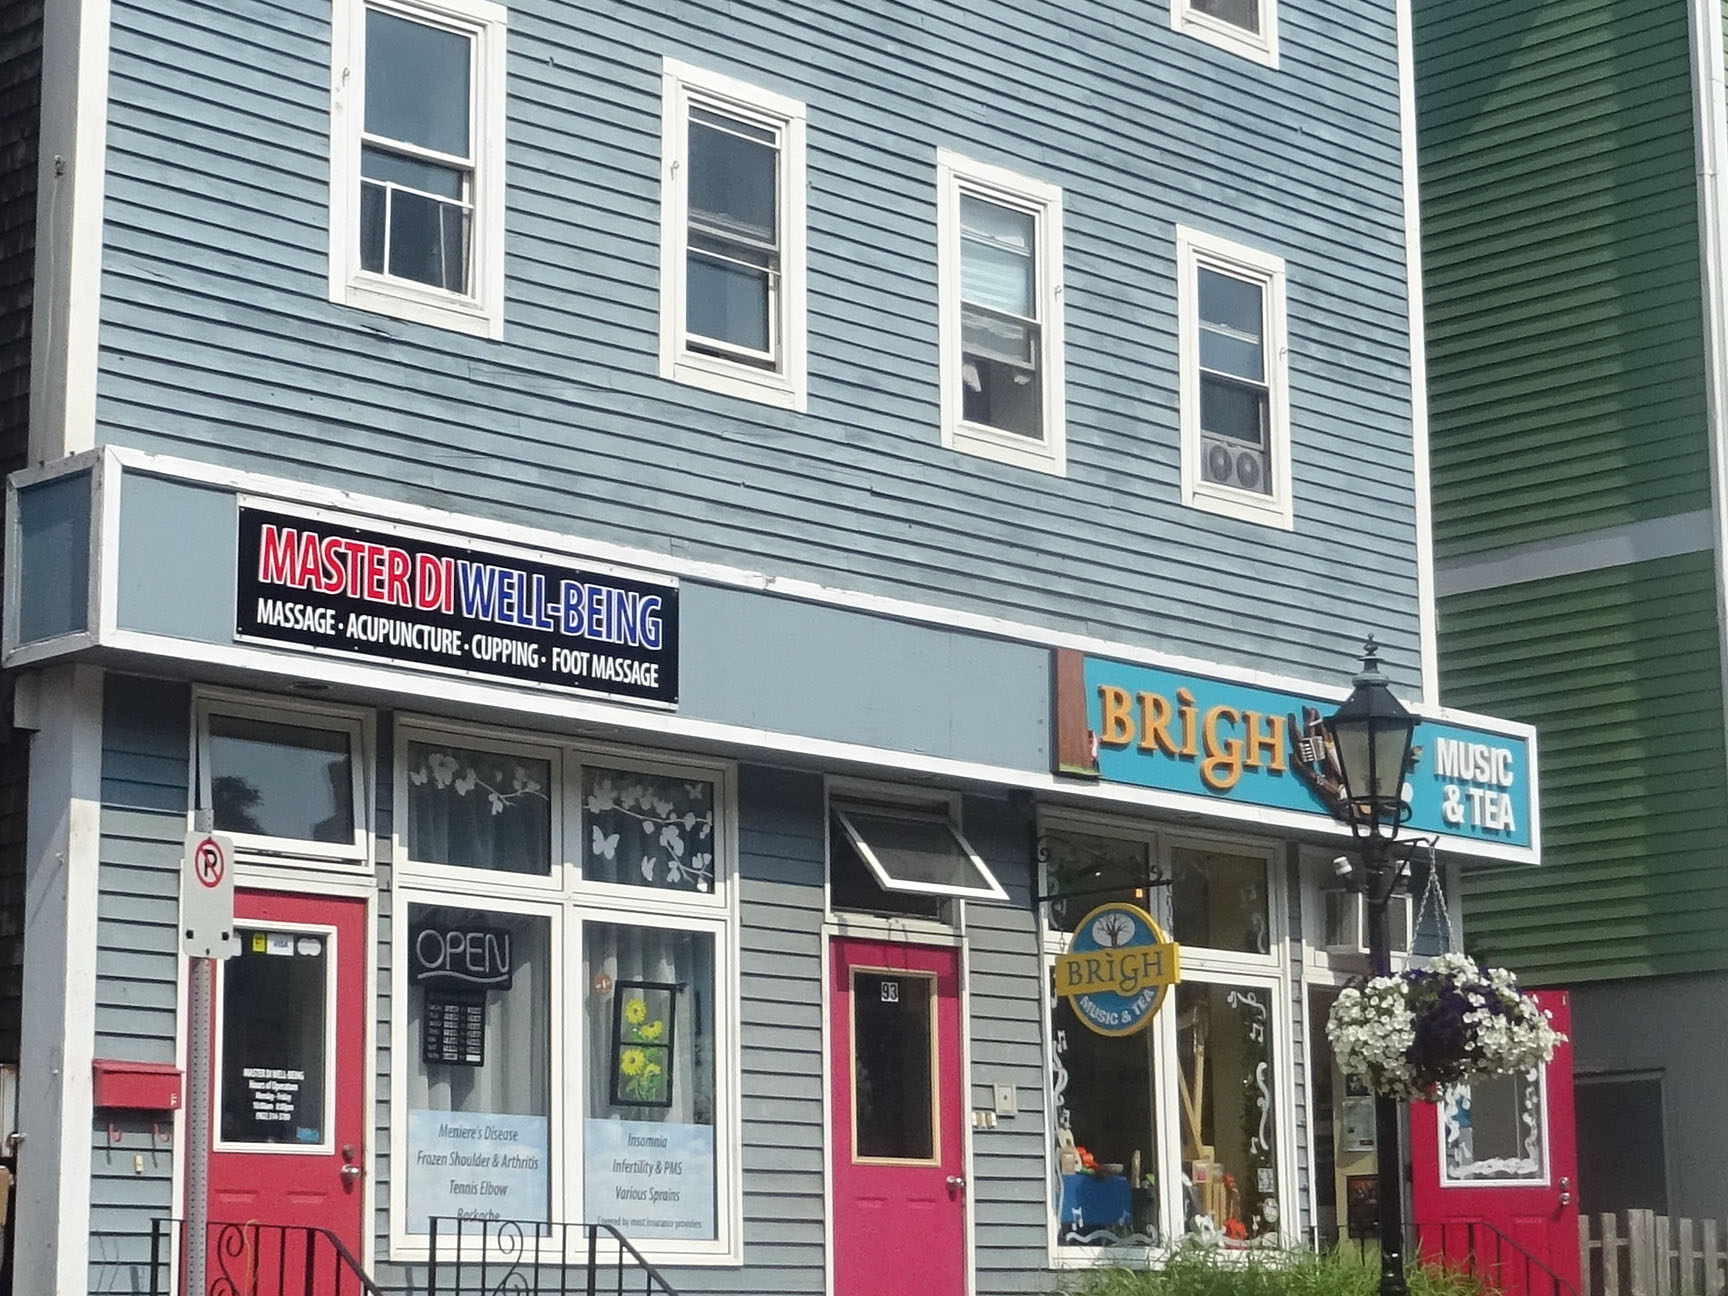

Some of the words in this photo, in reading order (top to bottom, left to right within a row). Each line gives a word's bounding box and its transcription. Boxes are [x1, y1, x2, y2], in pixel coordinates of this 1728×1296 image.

[259, 524, 411, 607] MASTER
[415, 555, 455, 614] DI
[456, 560, 663, 650] WELL-BEING
[257, 598, 336, 636] MASSAGE
[346, 620, 462, 657] ACUPUNCTURE
[472, 636, 539, 668] CUPPING
[552, 646, 589, 677] FOOT
[591, 654, 659, 688] MASSAGE
[1434, 737, 1513, 787] MUSIC
[1442, 785, 1466, 825] &
[1467, 788, 1516, 832] TEA
[416, 929, 510, 973] OPEN
[882, 983, 898, 1001] 93
[1080, 995, 1119, 1025] MUSIC
[1121, 1010, 1132, 1023] &
[1132, 989, 1155, 1015] TEA
[438, 1123, 483, 1140] Meniere's
[483, 1125, 519, 1142] Disease
[627, 1133, 668, 1148] Insomnia
[417, 1150, 447, 1165] Frozen
[450, 1151, 490, 1167] Shoulder
[492, 1153, 500, 1167] &
[501, 1154, 539, 1170] Arthritis
[613, 1159, 654, 1177] Infertility
[655, 1161, 662, 1174] &
[664, 1161, 683, 1175] PMS
[450, 1179, 478, 1195] Tennis
[480, 1181, 508, 1196] Elbow
[616, 1185, 647, 1200] Various
[649, 1187, 680, 1204] Sprains
